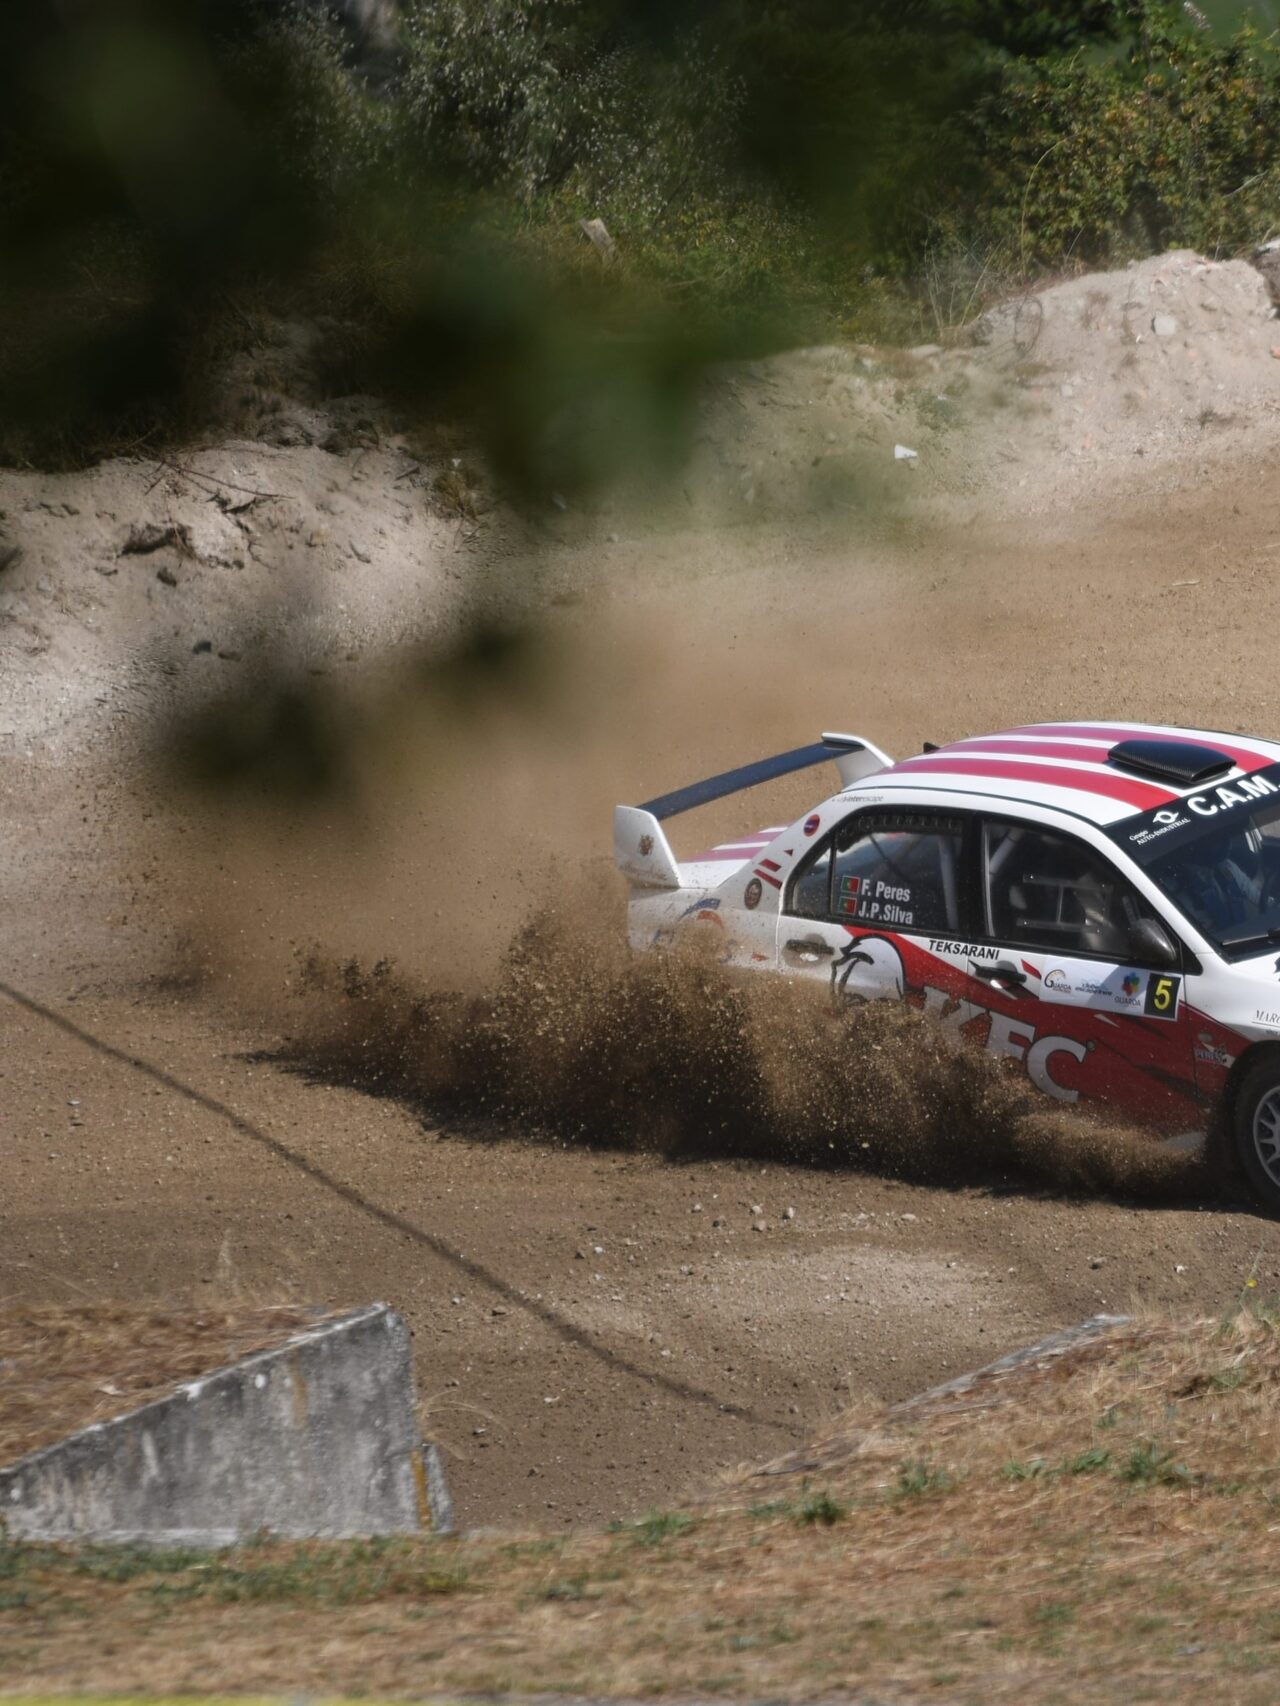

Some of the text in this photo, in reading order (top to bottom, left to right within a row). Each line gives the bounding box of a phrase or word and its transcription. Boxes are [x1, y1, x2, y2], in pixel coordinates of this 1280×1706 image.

[1136, 817, 1191, 846] AUTO-INDUSTRIAL
[861, 878, 911, 902] F. Peres
[858, 901, 913, 925] J.P.Silva
[928, 939, 1000, 961] TEKSARANI
[1153, 979, 1173, 1010] 5
